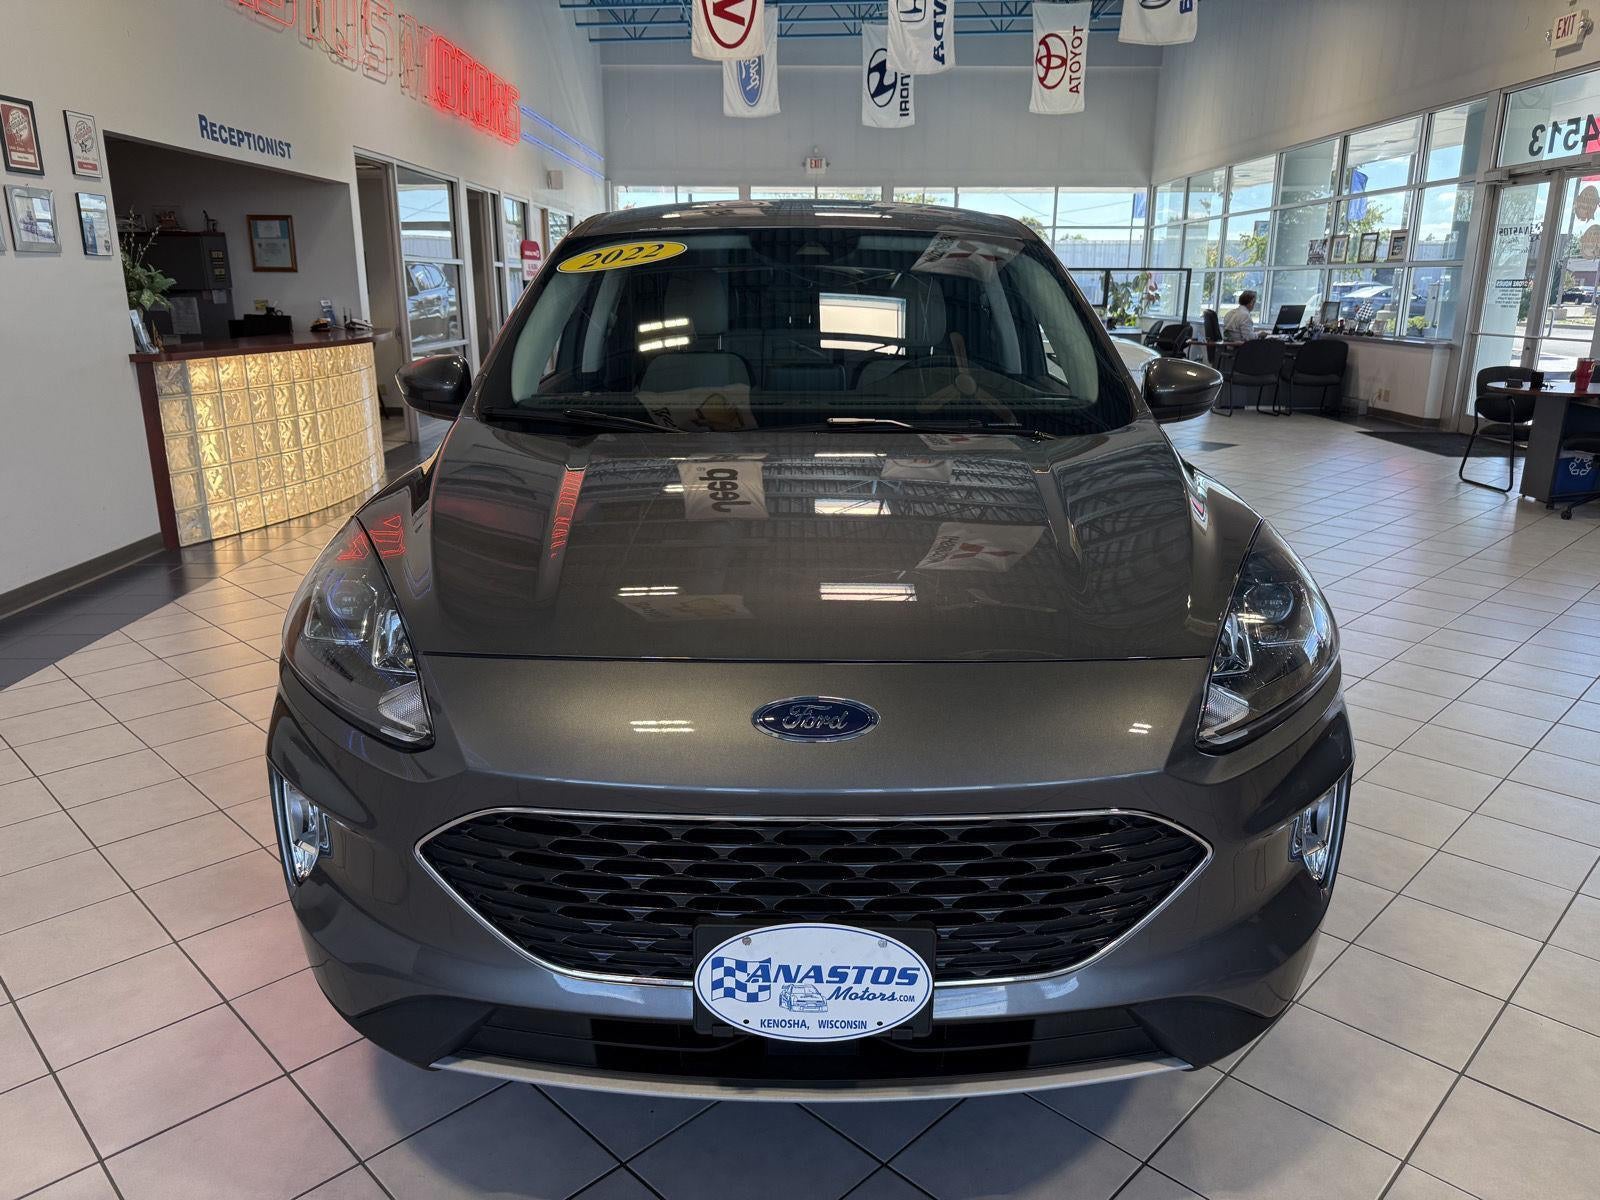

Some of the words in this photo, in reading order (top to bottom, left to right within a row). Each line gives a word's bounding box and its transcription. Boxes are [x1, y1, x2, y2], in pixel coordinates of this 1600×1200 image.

[1556, 14, 1577, 40] EXIT
[400, 14, 520, 144] MOTORS
[810, 159, 823, 169] EXIT
[579, 243, 665, 269] 2022
[781, 704, 849, 730] Ford
[745, 963, 921, 986] ANASTOS
[760, 1018, 810, 1030] KENOSHA,
[818, 1019, 867, 1030] WISCONSIN
